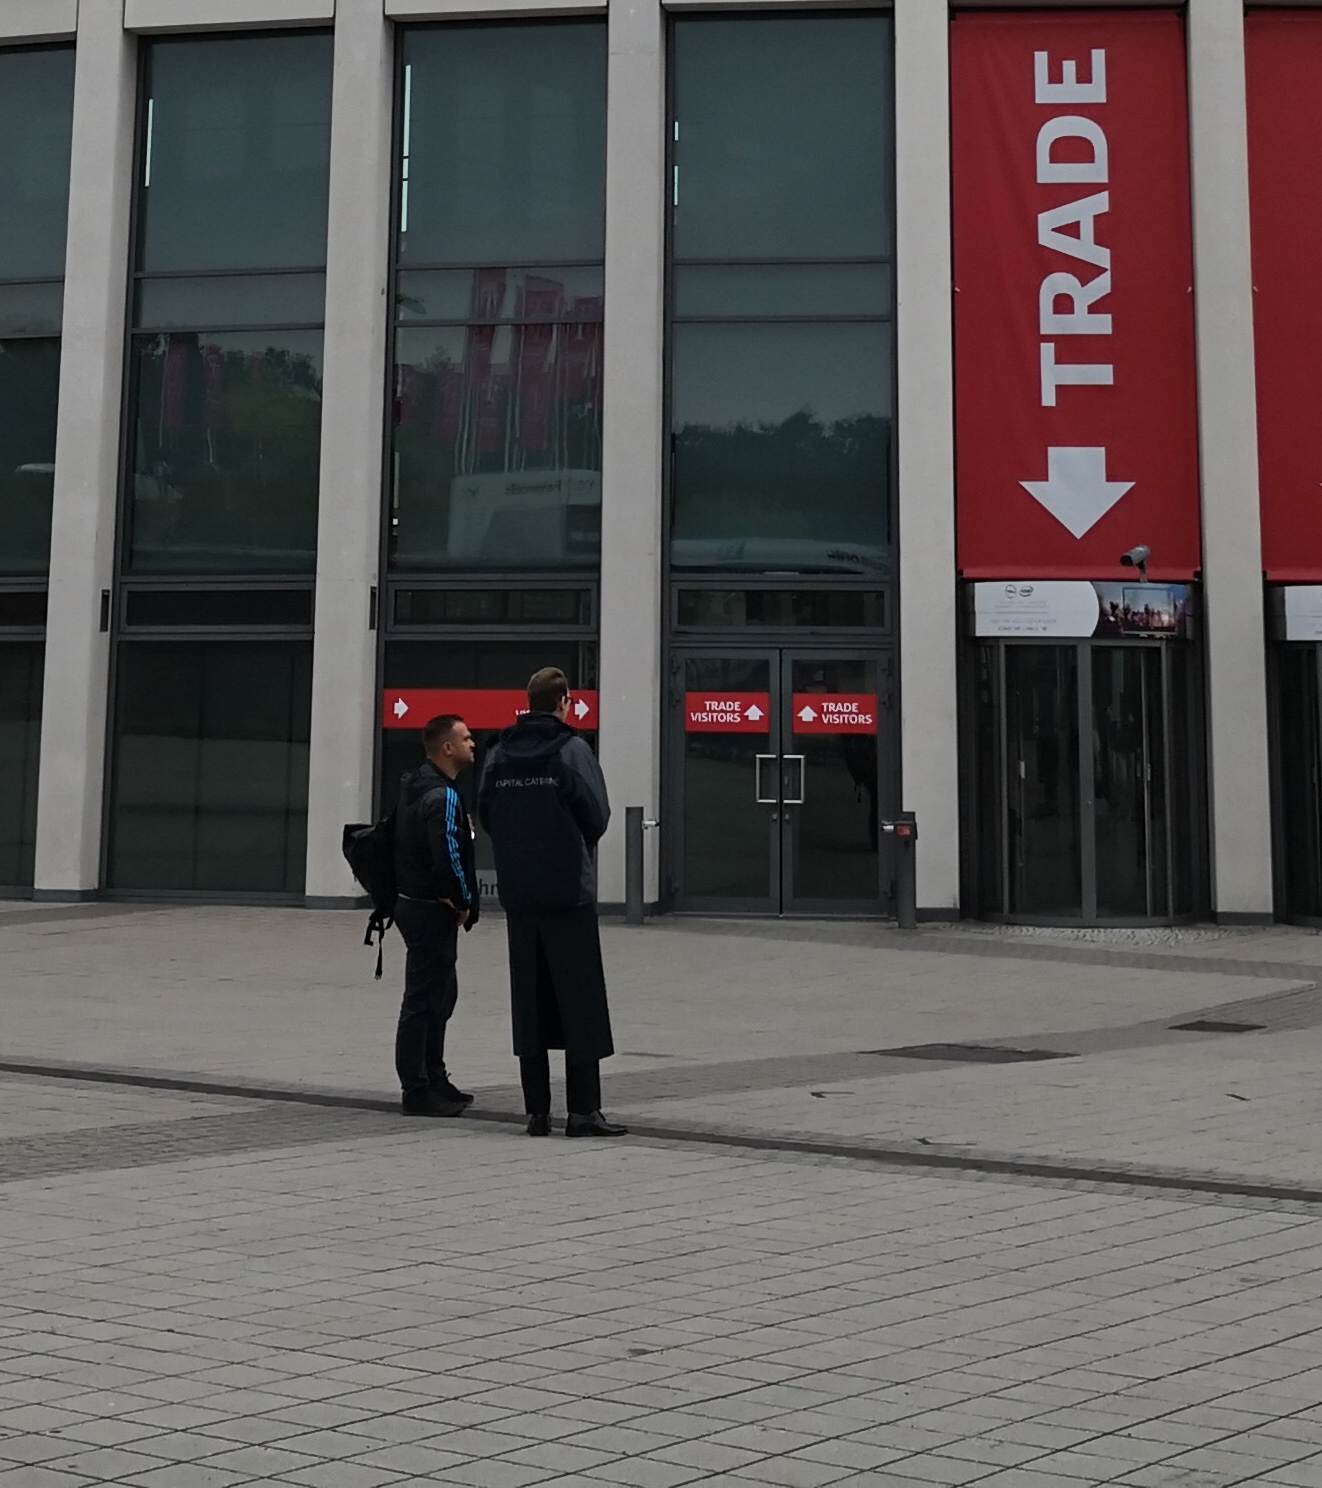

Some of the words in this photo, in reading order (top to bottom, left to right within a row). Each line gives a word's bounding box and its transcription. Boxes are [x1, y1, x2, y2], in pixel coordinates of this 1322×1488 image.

[1033, 47, 1115, 407] TRADE
[704, 701, 742, 712] TRADE
[821, 702, 859, 713] TRADE
[690, 712, 742, 723] VISITORS
[821, 714, 873, 725] VISITORS
[524, 776, 560, 787] CATENG
